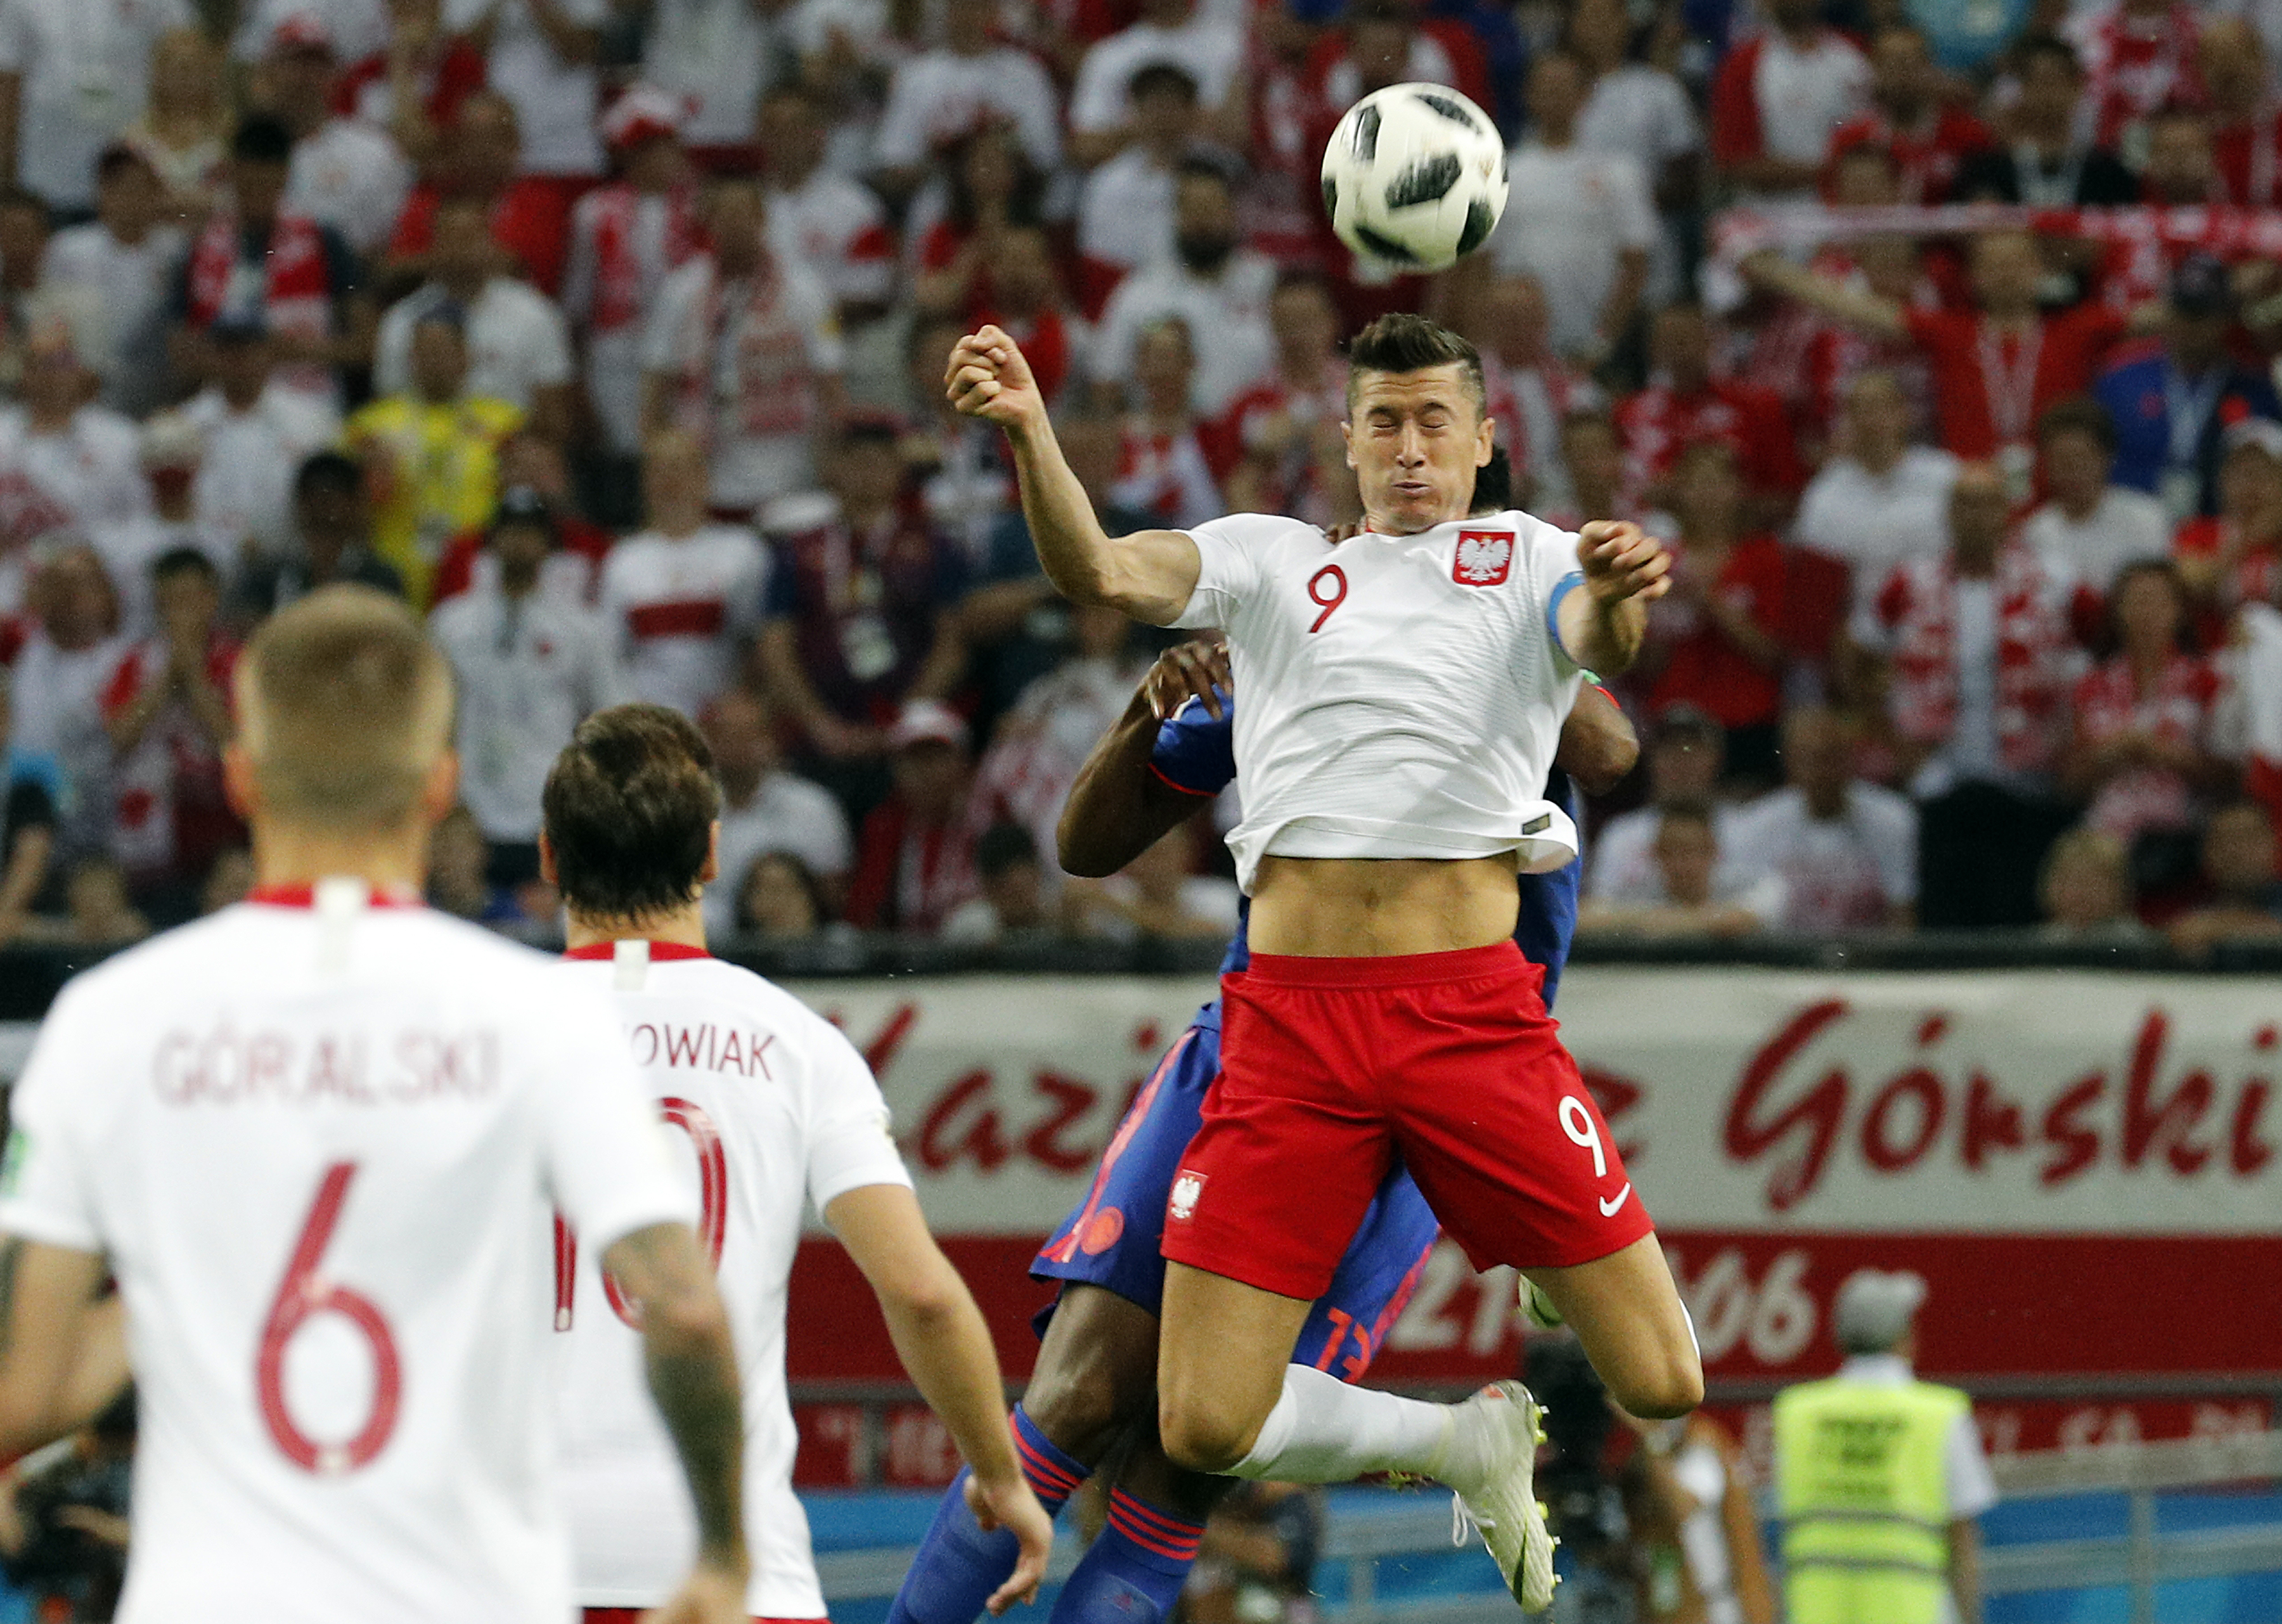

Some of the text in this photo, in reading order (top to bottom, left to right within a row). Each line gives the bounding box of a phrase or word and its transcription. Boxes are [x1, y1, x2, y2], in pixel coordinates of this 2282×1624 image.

[1308, 564, 1347, 633] 9
[153, 1017, 500, 1105] GÓRALSKI
[624, 1023, 775, 1081] OWIAK
[1558, 1095, 1607, 1177] 9
[1719, 994, 2278, 1212] Górski
[255, 1160, 406, 1474] 6
[1662, 1246, 1815, 1365] 06
